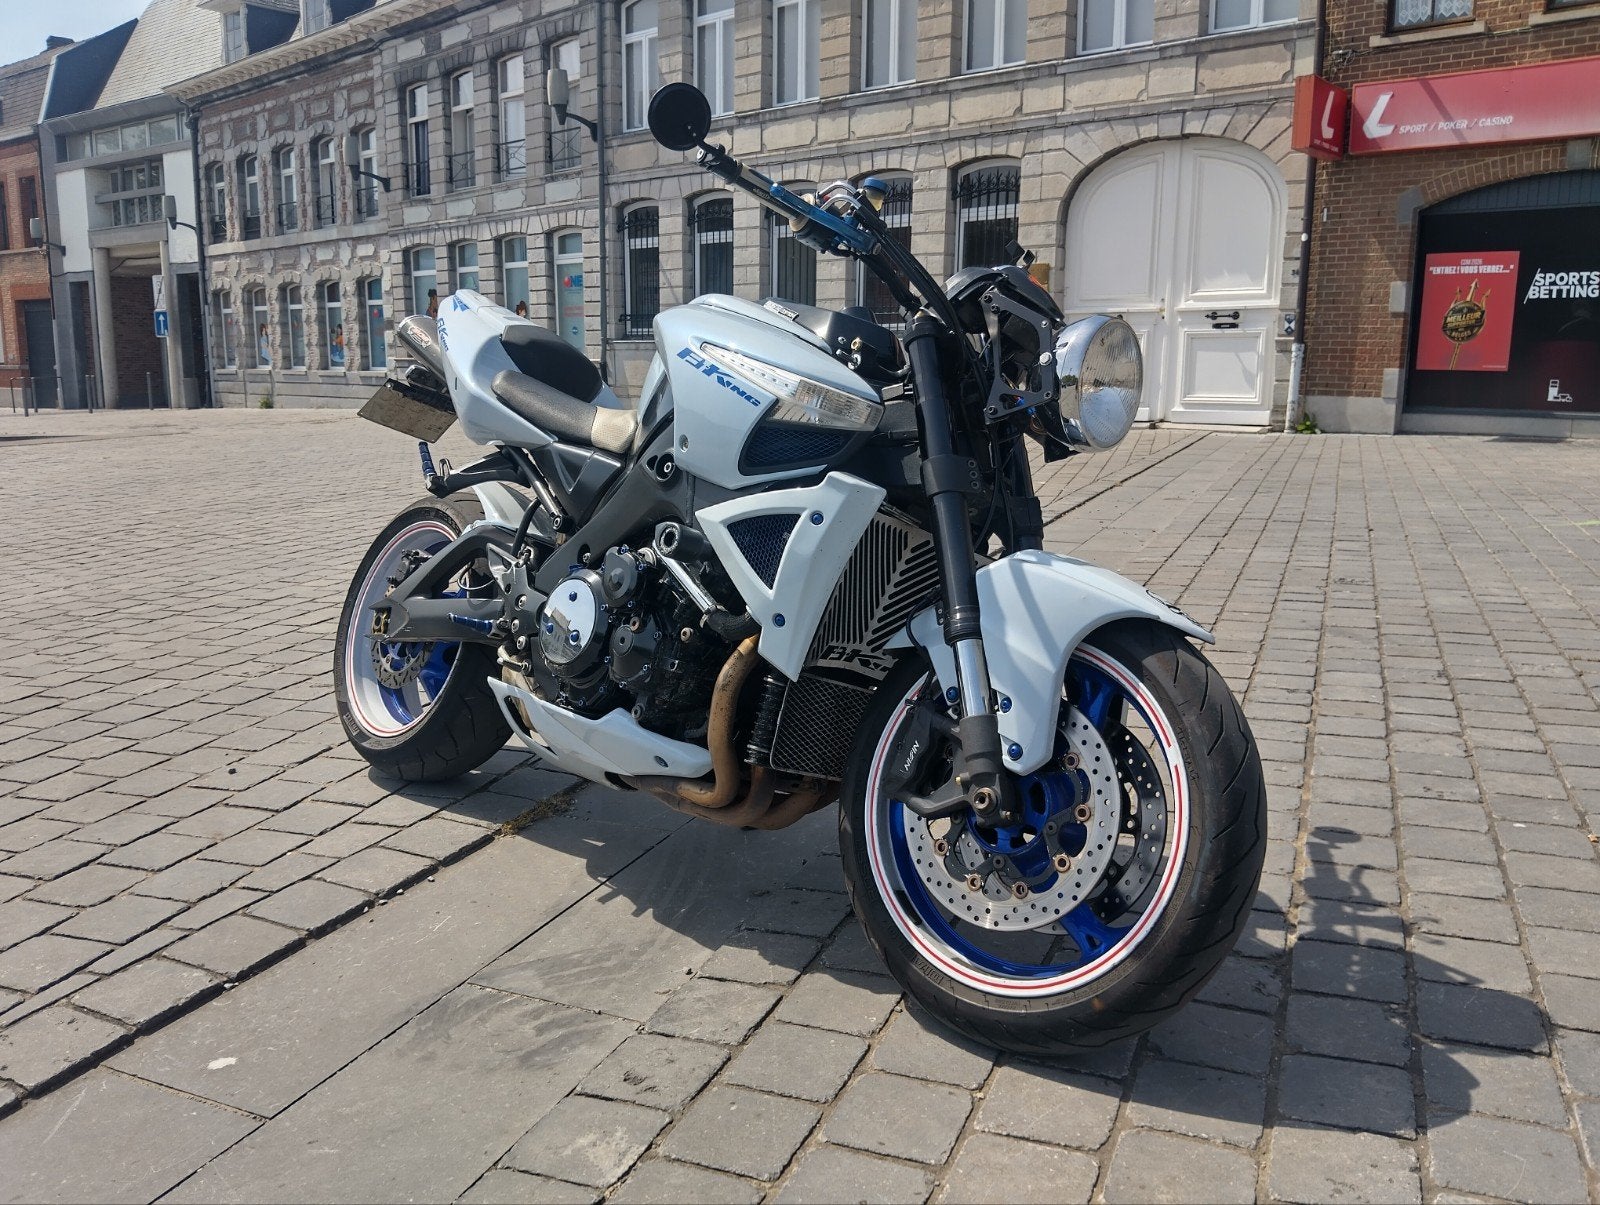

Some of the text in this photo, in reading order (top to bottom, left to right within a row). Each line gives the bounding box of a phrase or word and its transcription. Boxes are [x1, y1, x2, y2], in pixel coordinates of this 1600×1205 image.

[1399, 123, 1428, 134] SPORT
[1437, 119, 1468, 131] POKER
[1478, 116, 1514, 127] CASINO
[1460, 265, 1478, 274] VOUS
[1534, 271, 1600, 286] SPORTS
[1528, 285, 1600, 299] BETTING
[1446, 311, 1482, 324] MEILLEUR
